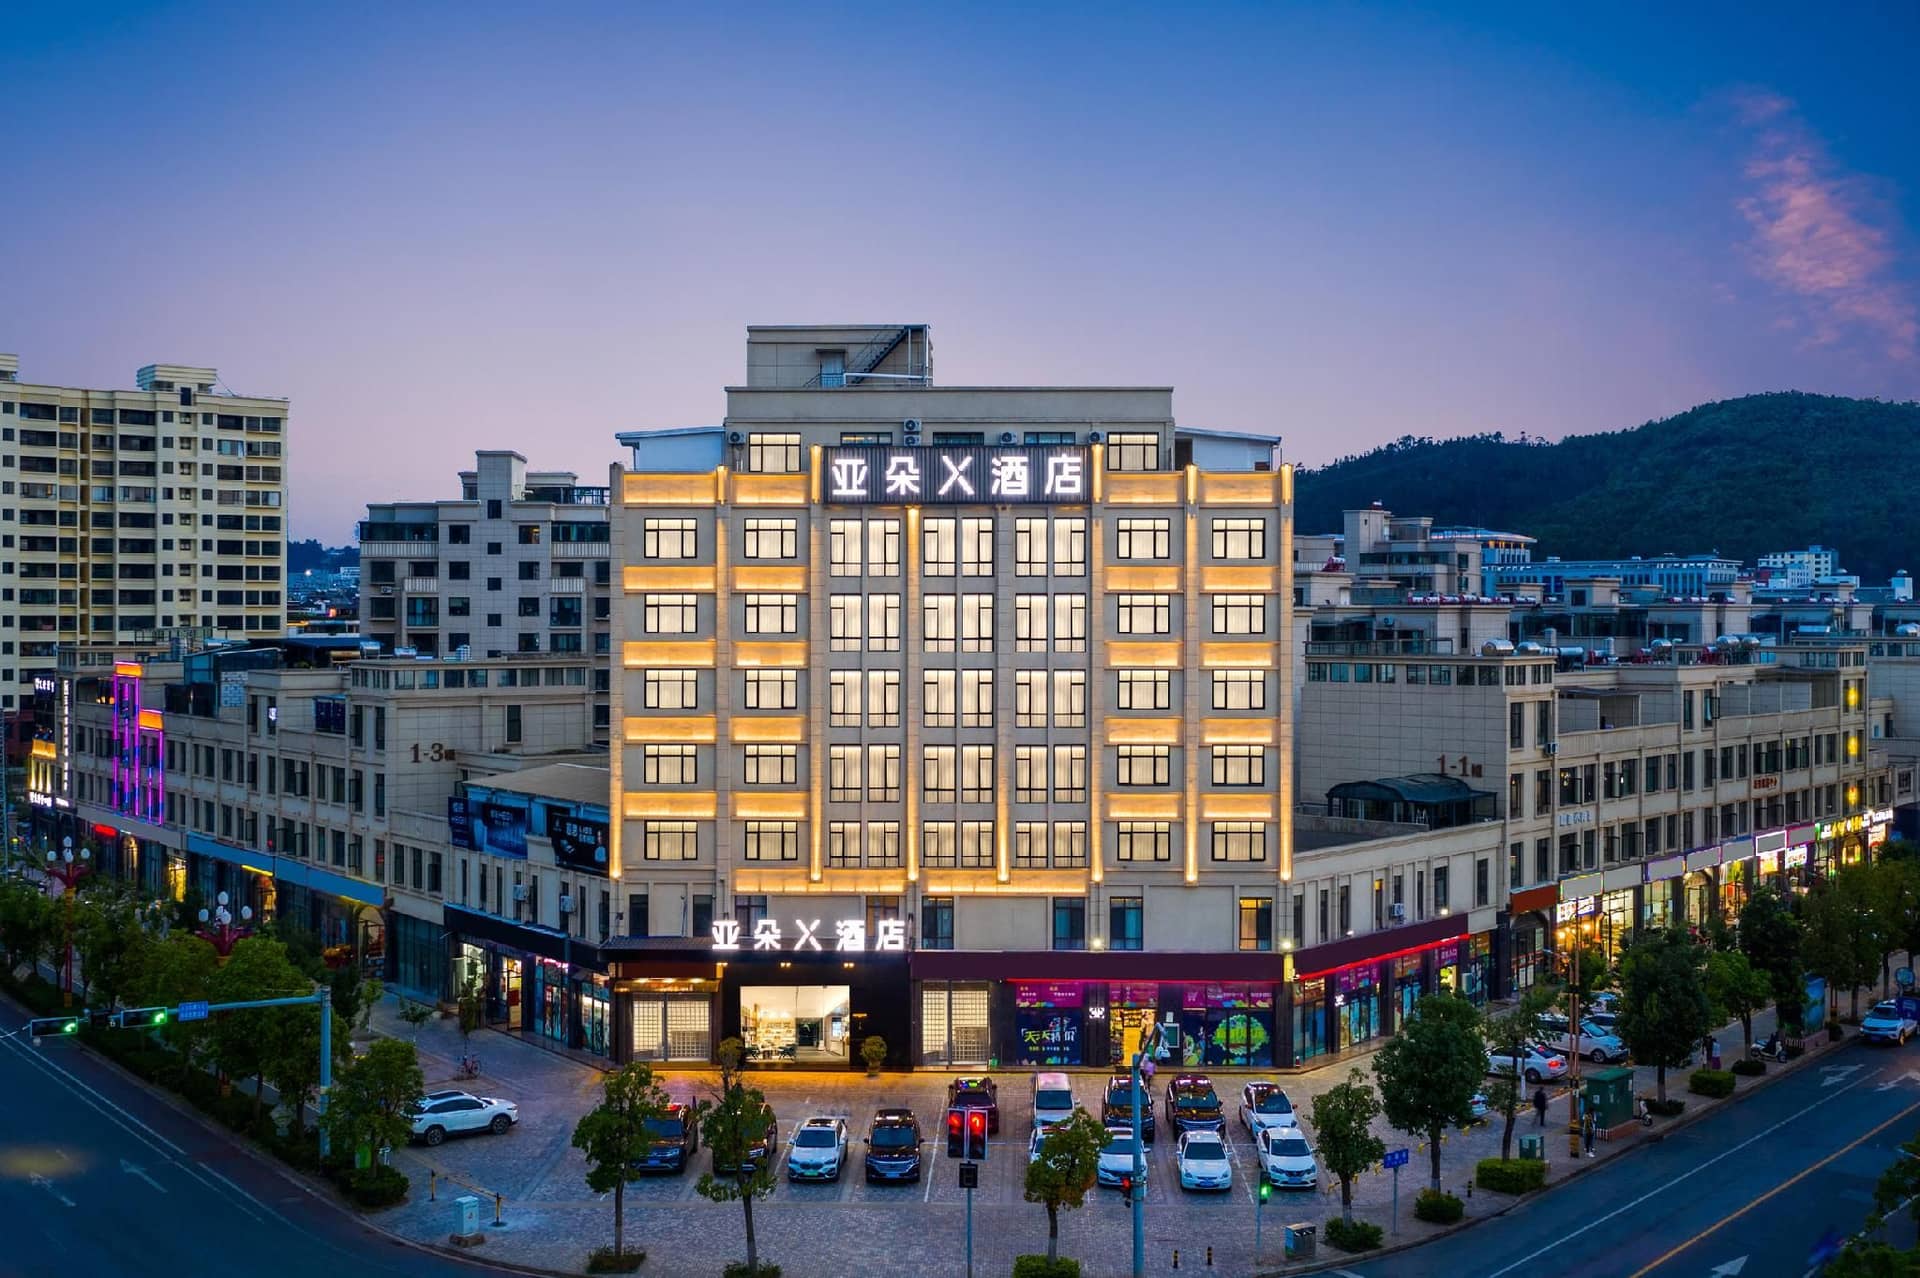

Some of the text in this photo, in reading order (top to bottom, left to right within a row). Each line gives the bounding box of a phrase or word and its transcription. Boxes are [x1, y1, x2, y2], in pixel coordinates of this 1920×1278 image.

[832, 454, 1082, 496] 亚朵X酒店
[711, 918, 905, 951] 亚朵X酒店
